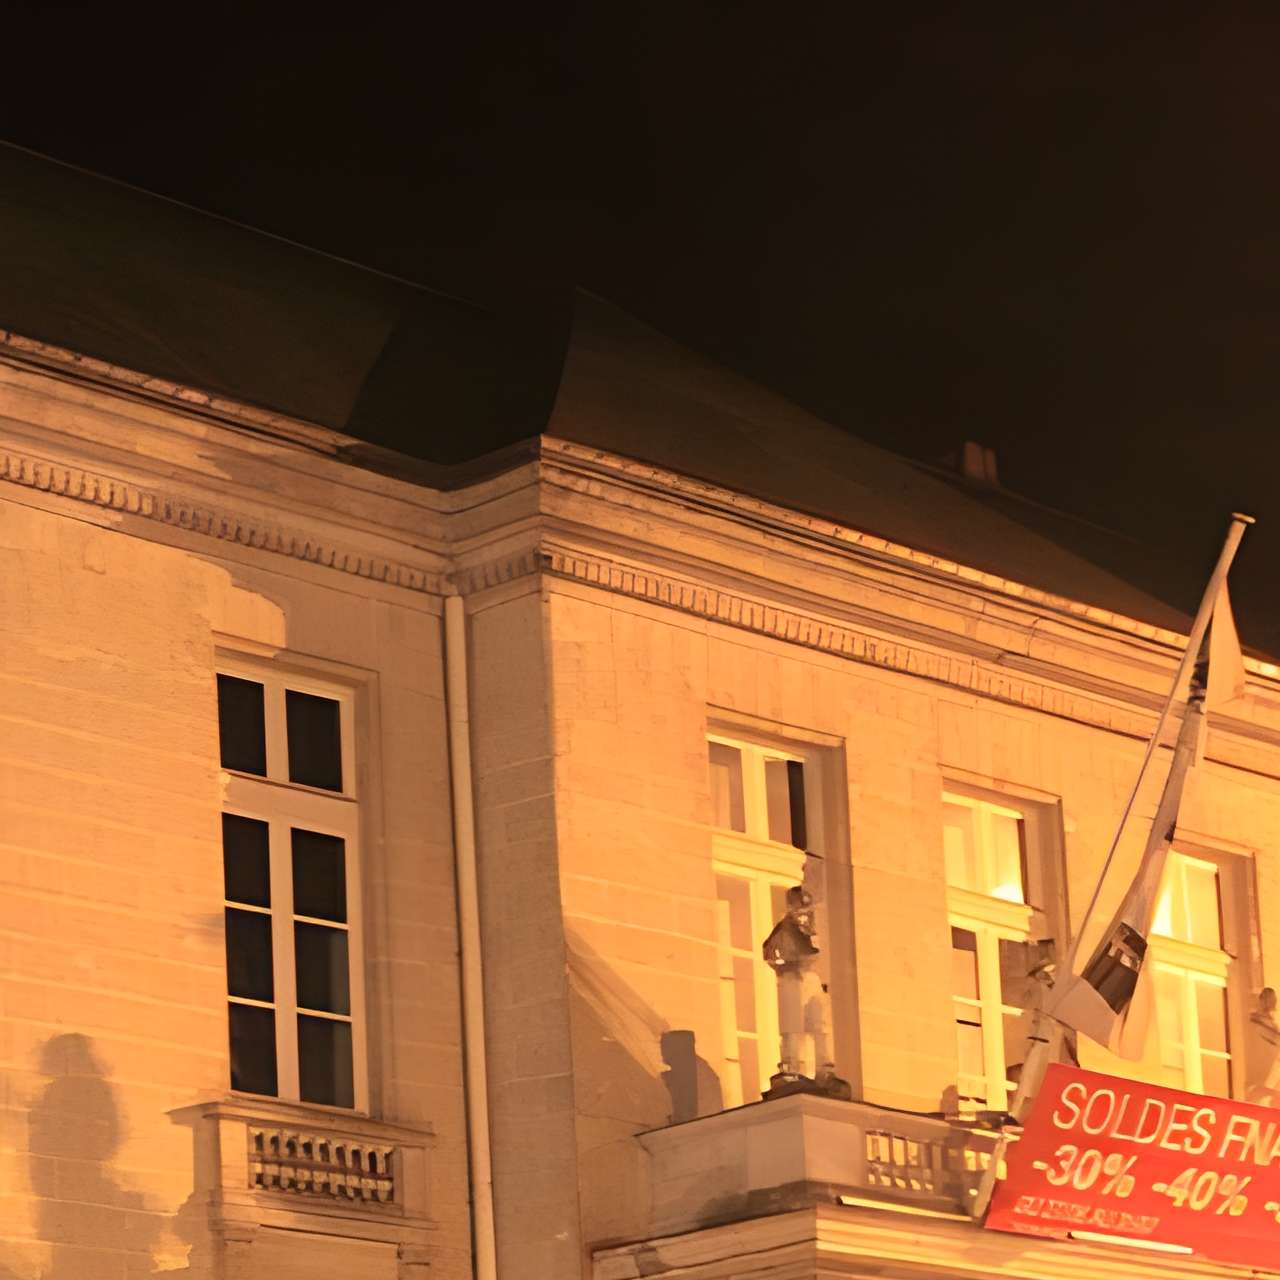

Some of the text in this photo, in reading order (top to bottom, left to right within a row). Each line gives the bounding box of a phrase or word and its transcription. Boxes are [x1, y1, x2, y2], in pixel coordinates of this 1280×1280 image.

[1052, 1082, 1217, 1155] SOLDES
[1032, 1144, 1138, 1198] -30%
[1151, 1167, 1252, 1216] -40%
